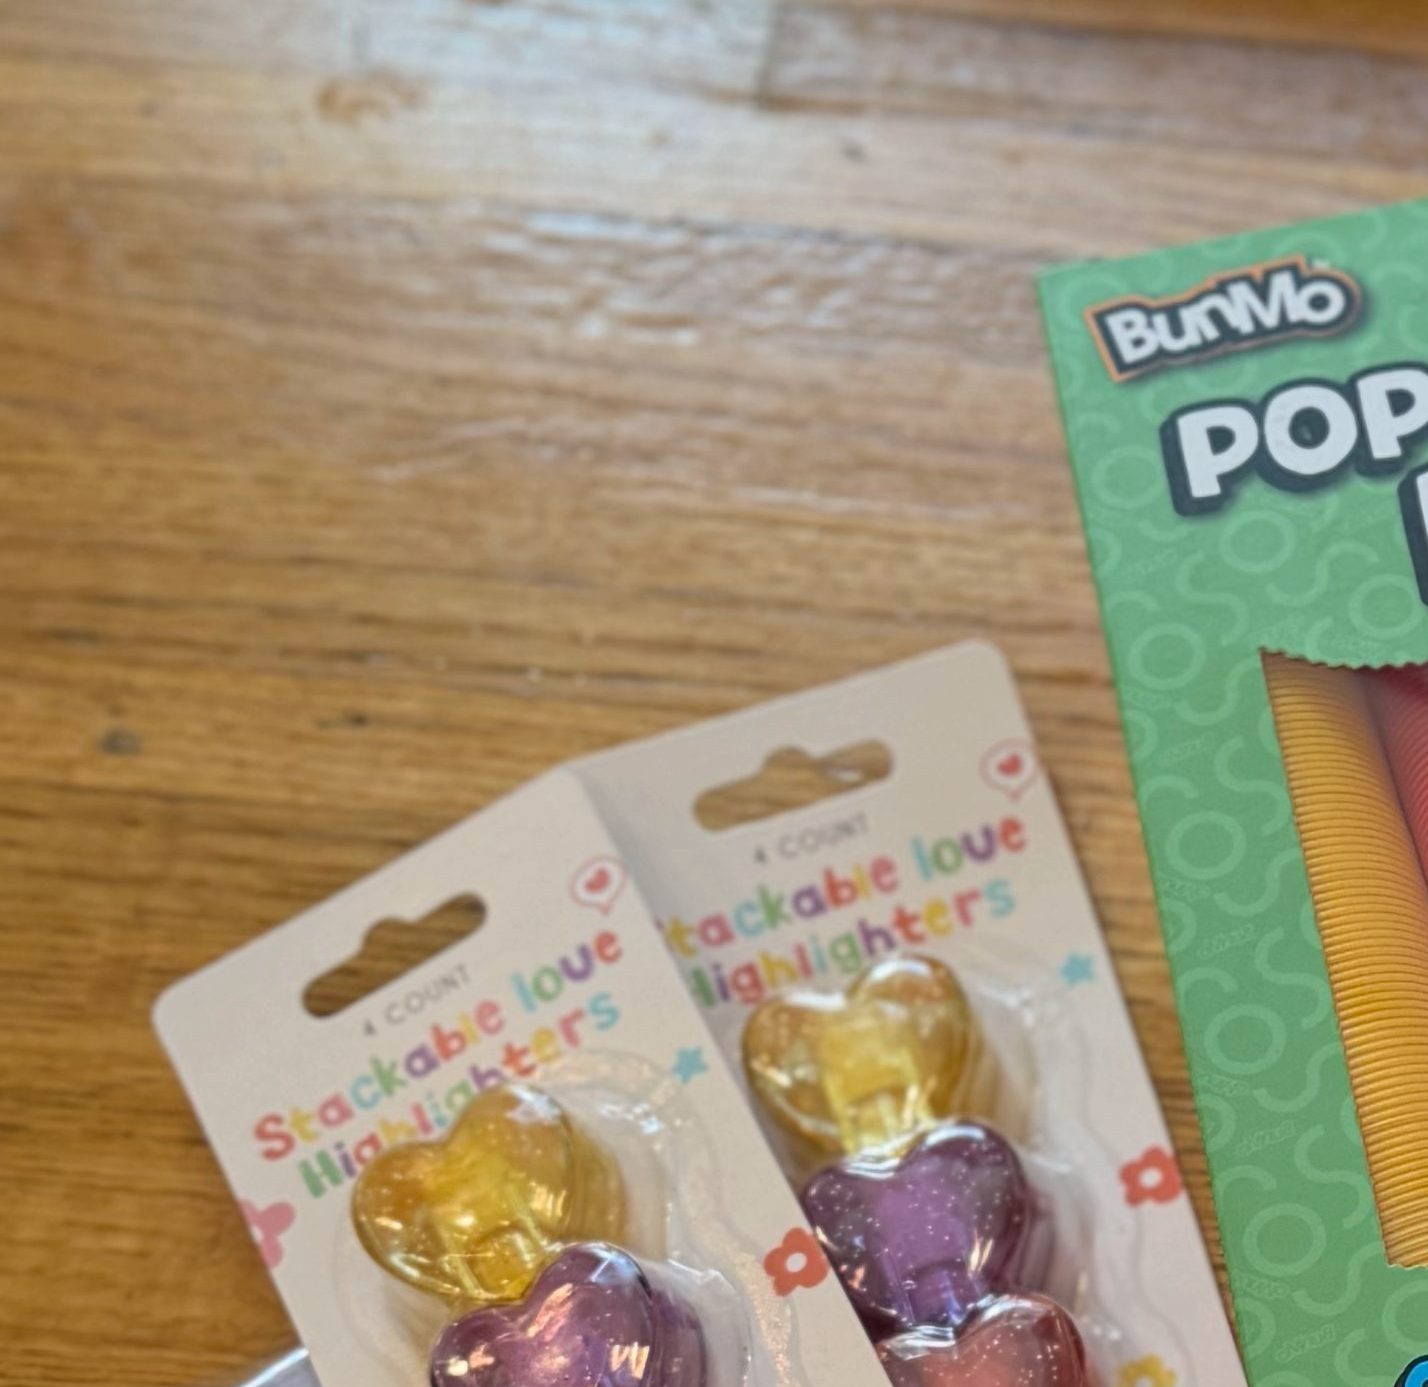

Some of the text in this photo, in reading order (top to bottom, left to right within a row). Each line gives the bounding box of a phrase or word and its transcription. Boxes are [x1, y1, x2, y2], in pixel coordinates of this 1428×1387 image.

[1103, 268, 1347, 366] BunMo
[657, 854, 899, 957] tackable
[252, 998, 506, 1162] Stackable
